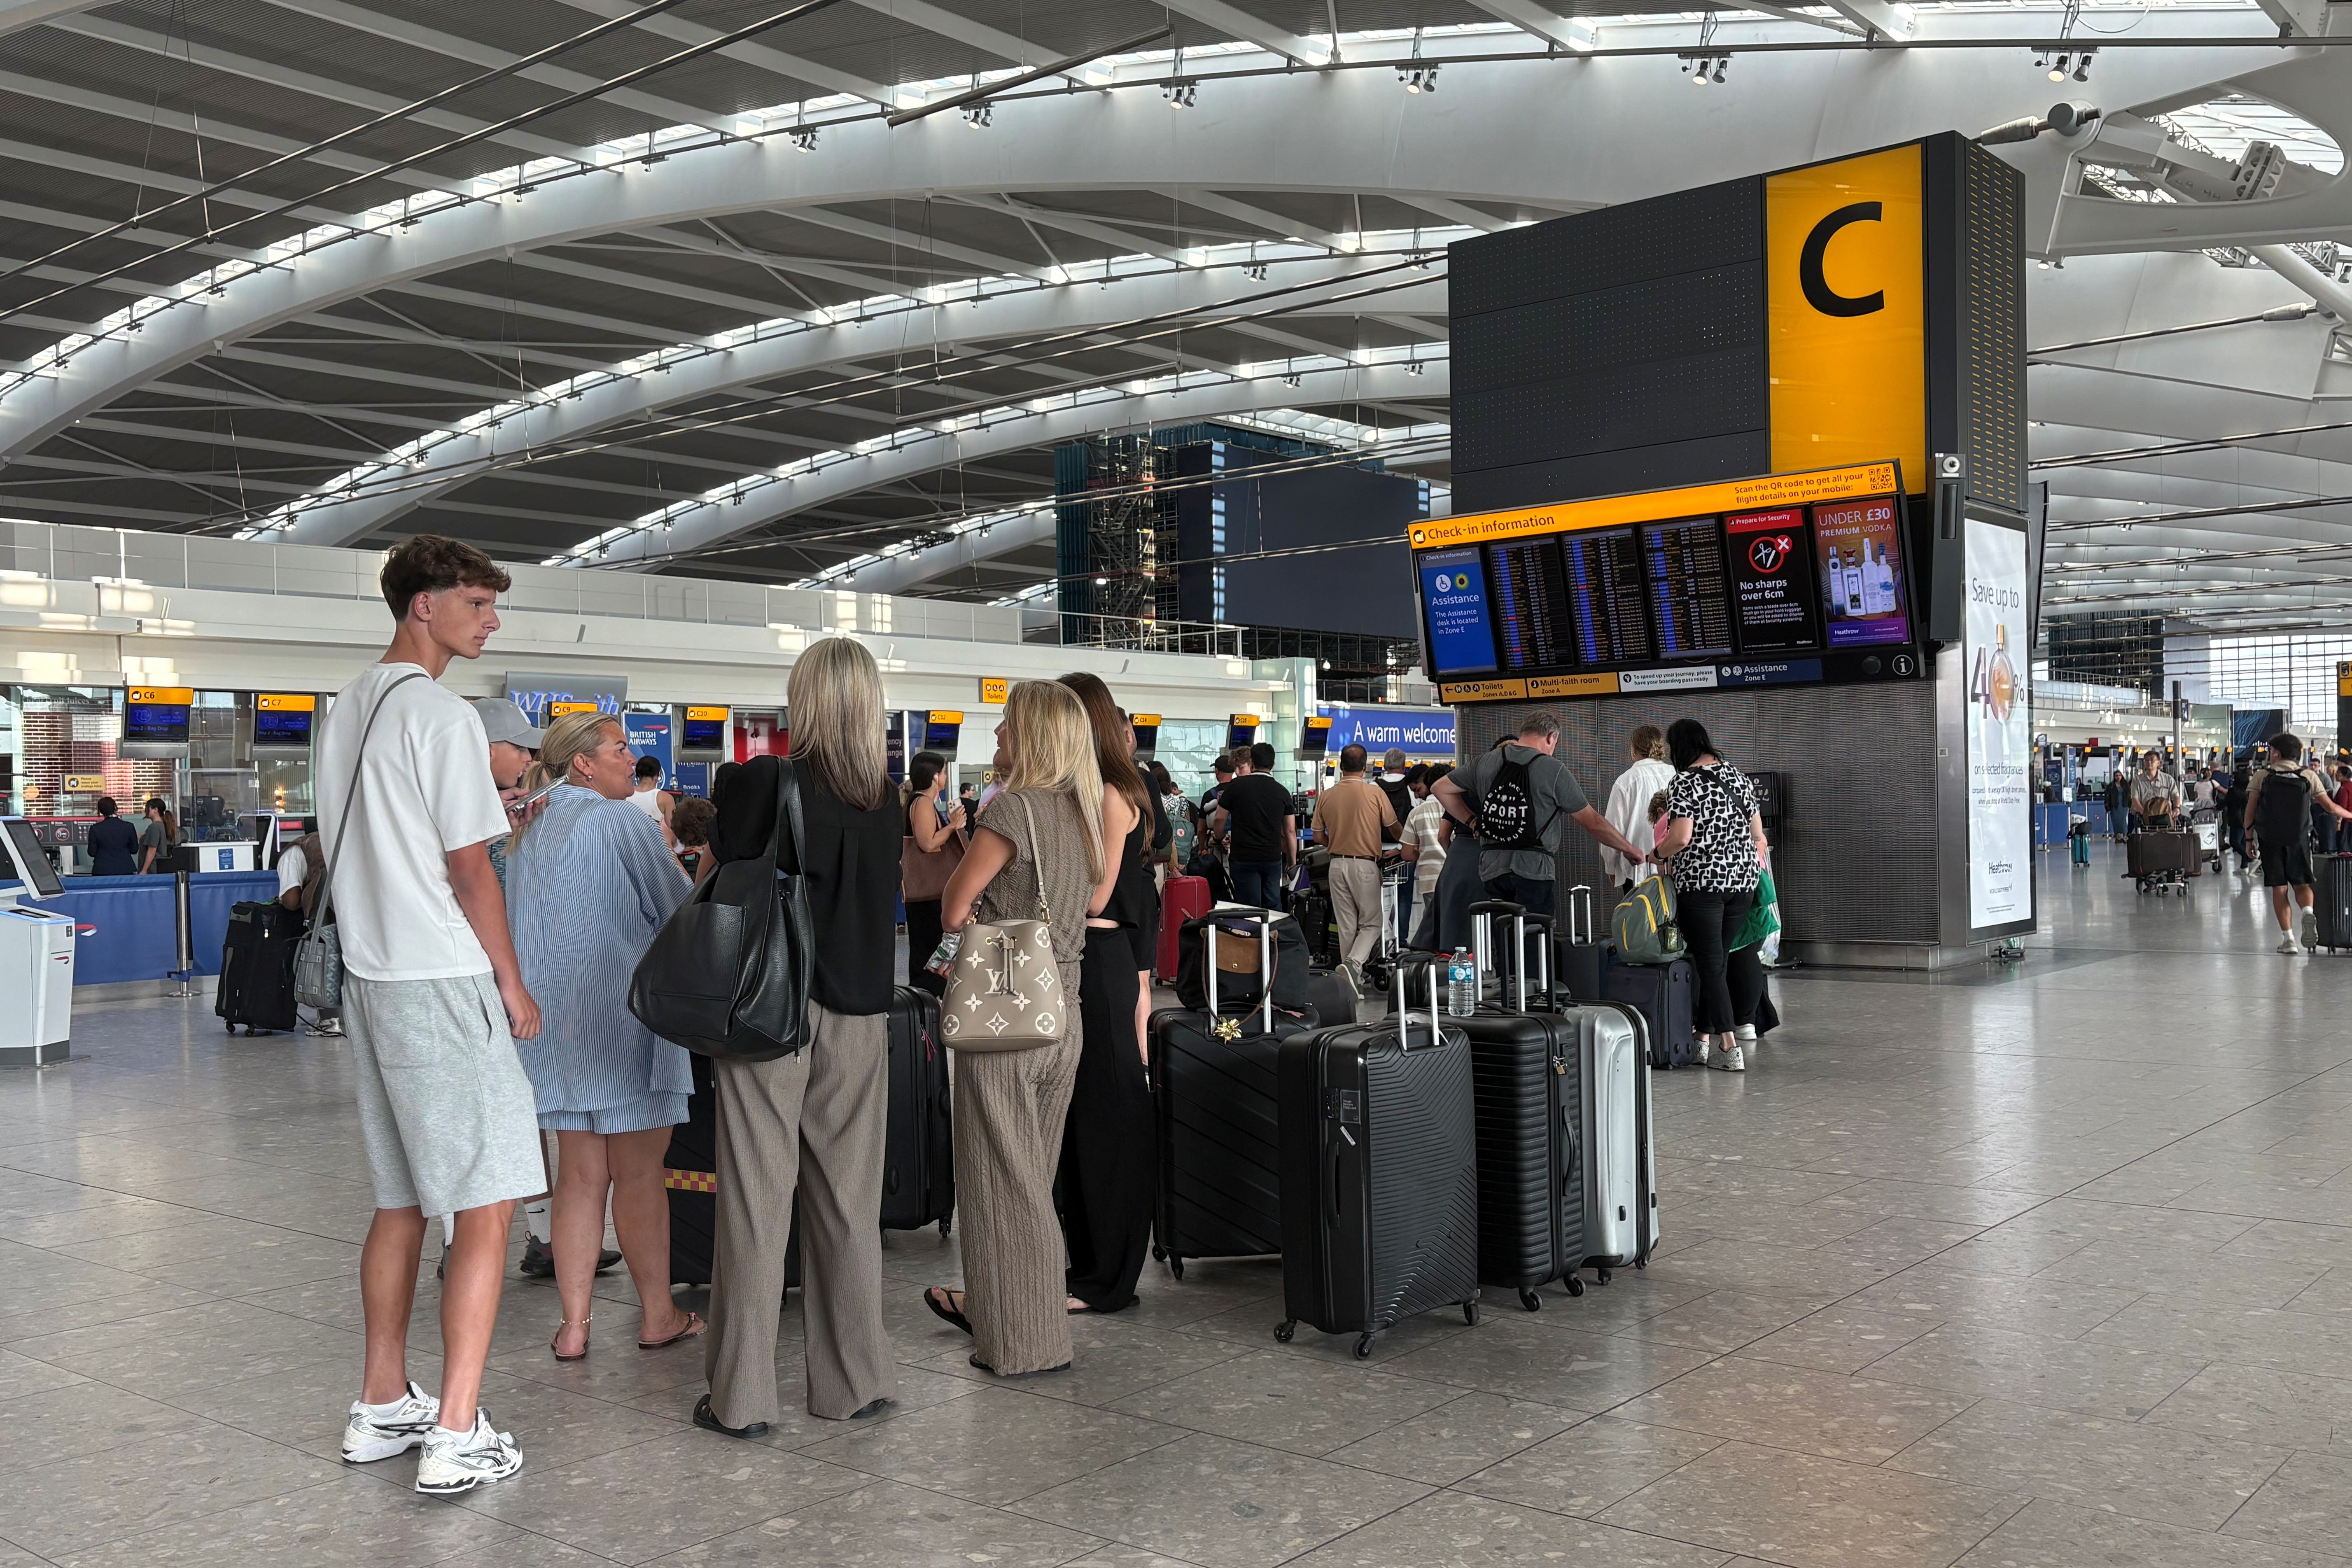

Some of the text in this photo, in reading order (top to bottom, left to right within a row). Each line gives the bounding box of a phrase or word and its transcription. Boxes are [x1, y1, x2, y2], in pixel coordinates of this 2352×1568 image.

[1800, 201, 1885, 317] C
[1784, 480, 1803, 488] code
[1817, 477, 1829, 486] get
[1832, 474, 1842, 482] all
[1845, 473, 1863, 484] your
[1736, 495, 1757, 504] flight
[1760, 492, 1786, 501] details
[1801, 489, 1819, 498] your
[1822, 485, 1853, 494] mobile:
[1819, 508, 1890, 526] UNDER £30
[1428, 516, 1554, 539] Check-in information
[1820, 523, 1892, 537] PREMIUM VODKA
[1755, 579, 1787, 589] sharps
[1432, 594, 1479, 606] Assistance
[1765, 590, 1784, 599] 6cm
[1972, 577, 2019, 613] Save up to
[1448, 609, 1477, 617] Assistance
[1437, 618, 1449, 626] desk
[1744, 663, 1787, 674] Assistance
[1540, 678, 1579, 687] Multi-faith
[1354, 721, 1456, 744] A warm welcome
[1483, 800, 1528, 818] SPORT
